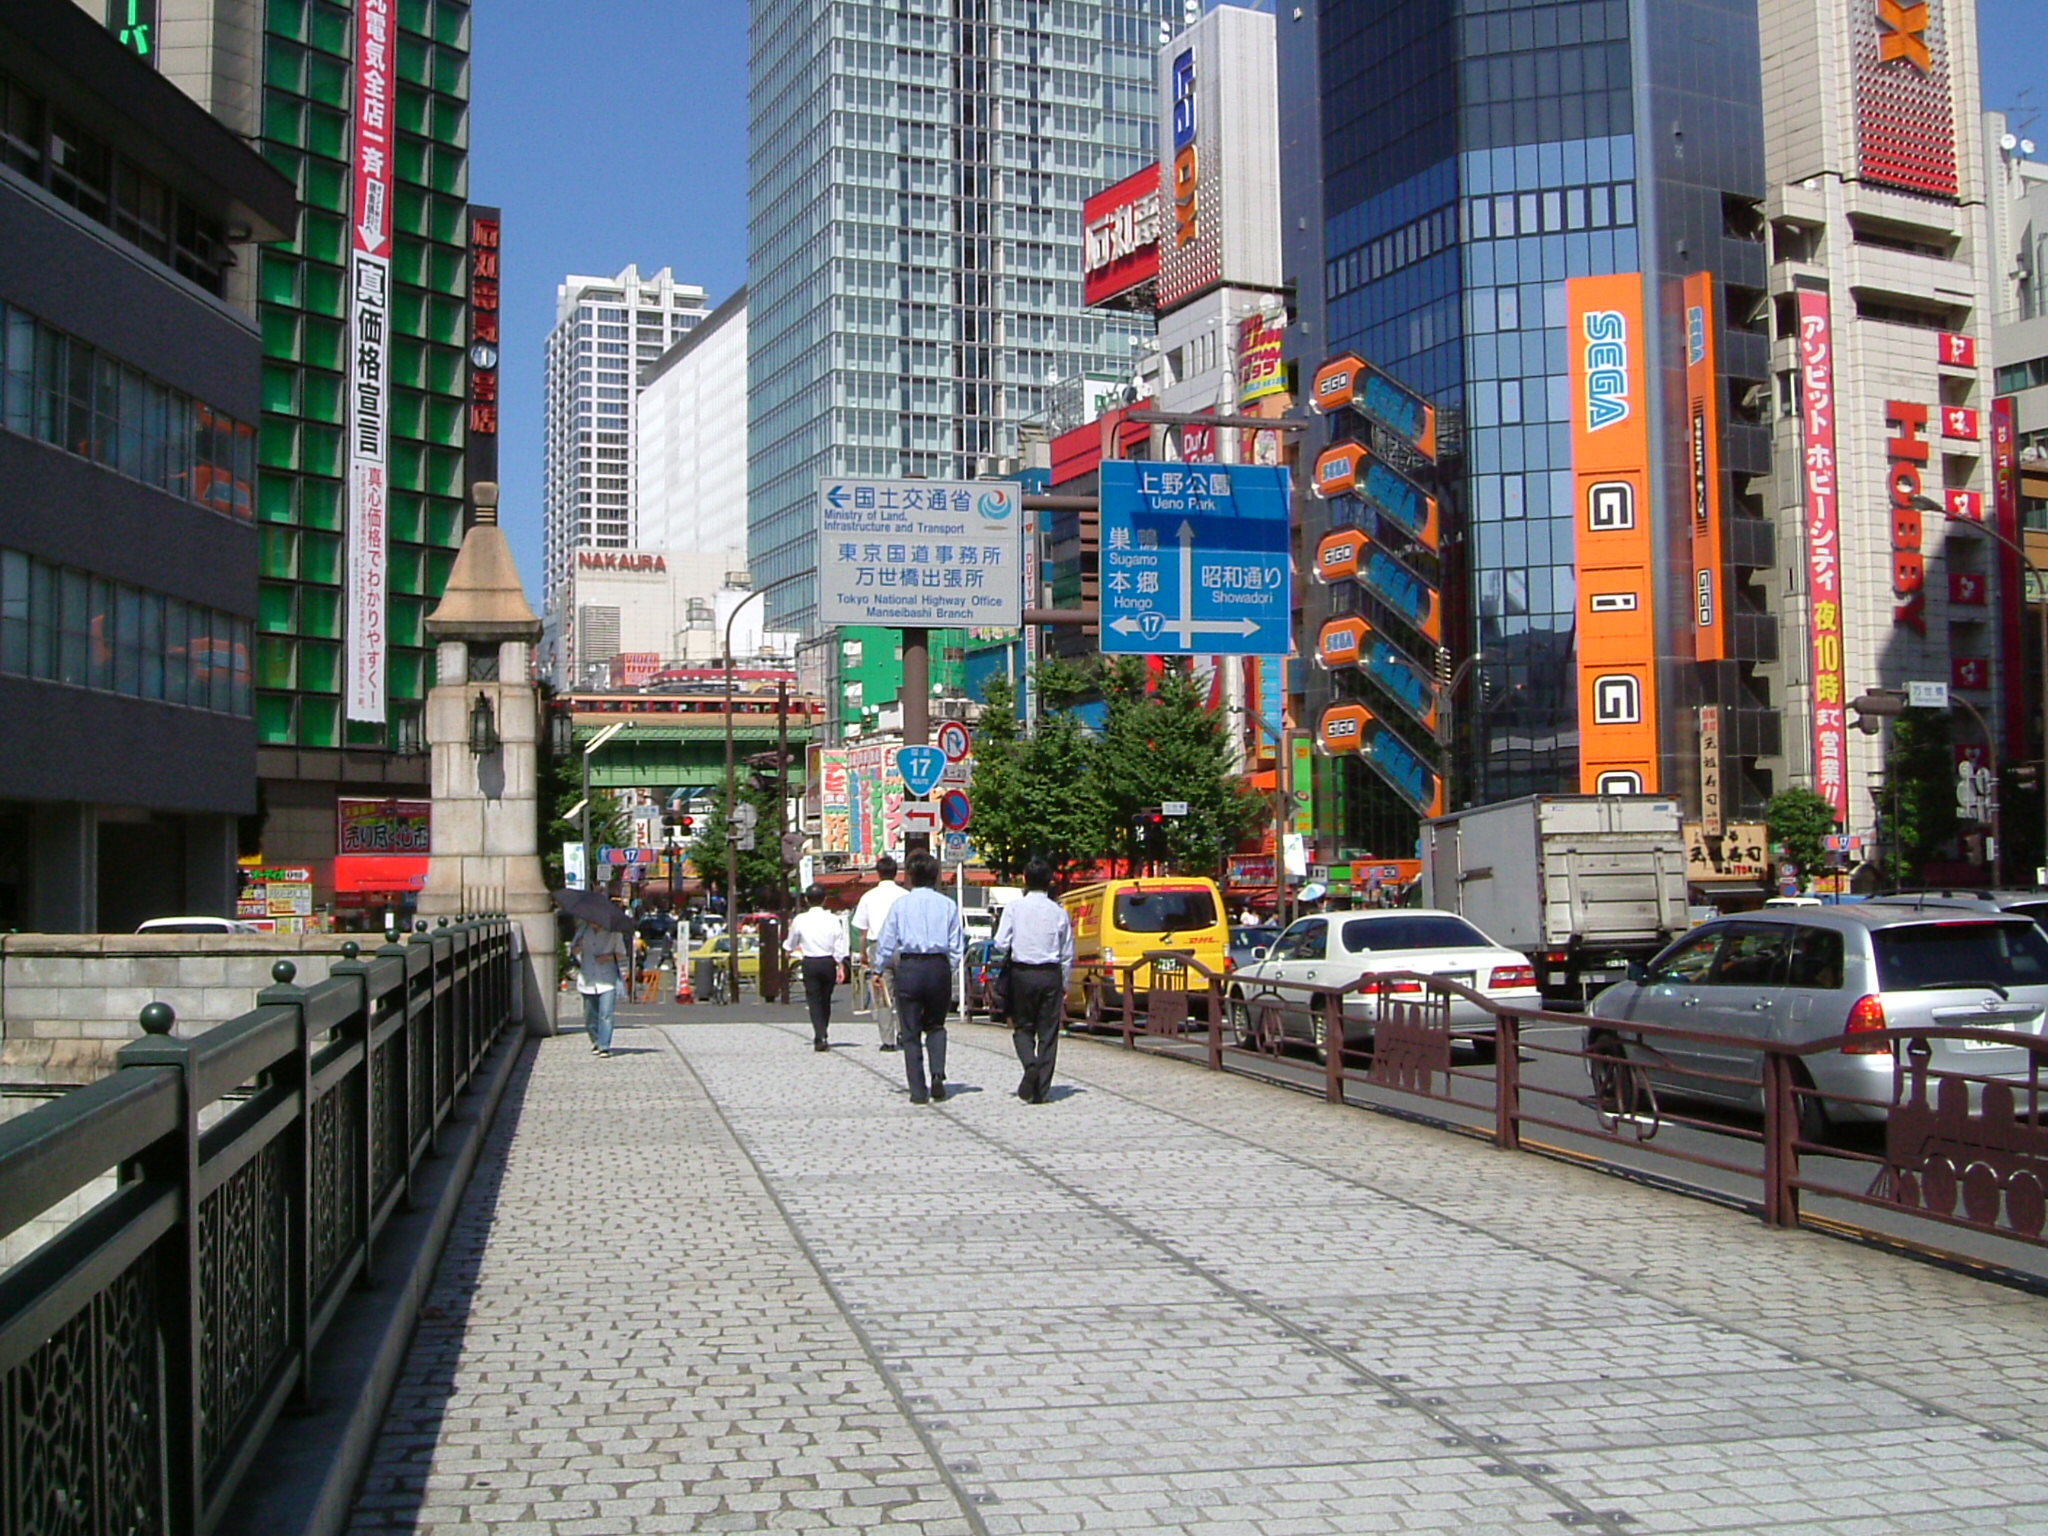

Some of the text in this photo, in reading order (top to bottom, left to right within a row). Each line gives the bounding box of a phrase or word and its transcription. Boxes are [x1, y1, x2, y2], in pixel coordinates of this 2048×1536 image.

[1687, 306, 1705, 366] SEGA
[357, 260, 384, 455] 真価格宣言
[1583, 311, 1630, 432] SEGA
[1801, 315, 1828, 435] アソビット
[1323, 457, 1351, 481] SEGA
[1137, 472, 1232, 496] 上野公園
[855, 487, 972, 512] 国土交通省
[1152, 497, 1216, 511] Ueno Park
[824, 509, 863, 522] Ministry
[867, 510, 877, 521] of
[1806, 443, 1834, 591] ホビーシティ
[1885, 400, 1929, 637] HOBBY
[824, 521, 964, 535] Infrastructure and Transport
[1109, 527, 1158, 551] 巣鴨
[579, 552, 666, 573] NAKAURA
[838, 543, 1001, 566] 東京国道事務所
[1109, 553, 1158, 568] Sugamo
[367, 467, 382, 709] 真心価格でわかりやすく!
[855, 567, 984, 588] 万世橋出張所
[1108, 571, 1158, 594] 本郷
[1202, 565, 1282, 589] 昭和通り
[837, 593, 1002, 607] Tokyo National Highway Office
[1114, 597, 1153, 611] Hongo
[1212, 591, 1273, 604] Showadori
[867, 607, 974, 619] Manseibashi Branch
[1142, 616, 1160, 632] 17
[1325, 630, 1354, 651] SEGA
[909, 758, 931, 777] 17
[625, 850, 635, 861] 17
